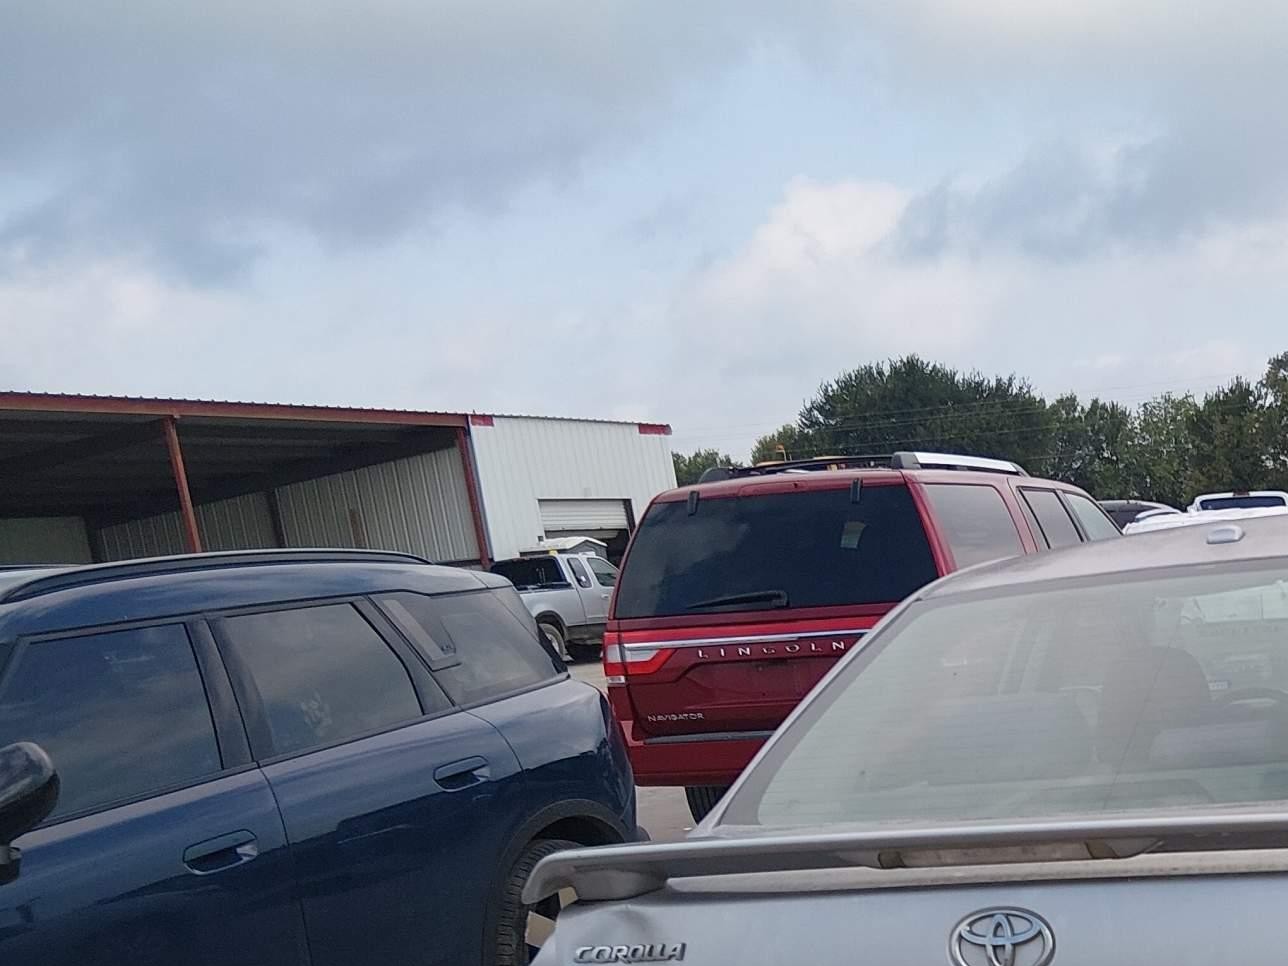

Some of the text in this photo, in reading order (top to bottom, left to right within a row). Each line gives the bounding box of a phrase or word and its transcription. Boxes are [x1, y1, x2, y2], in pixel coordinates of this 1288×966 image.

[697, 641, 846, 659] LINCOLN
[647, 712, 705, 722] NAVIGATOR
[574, 942, 687, 965] COROLLA
